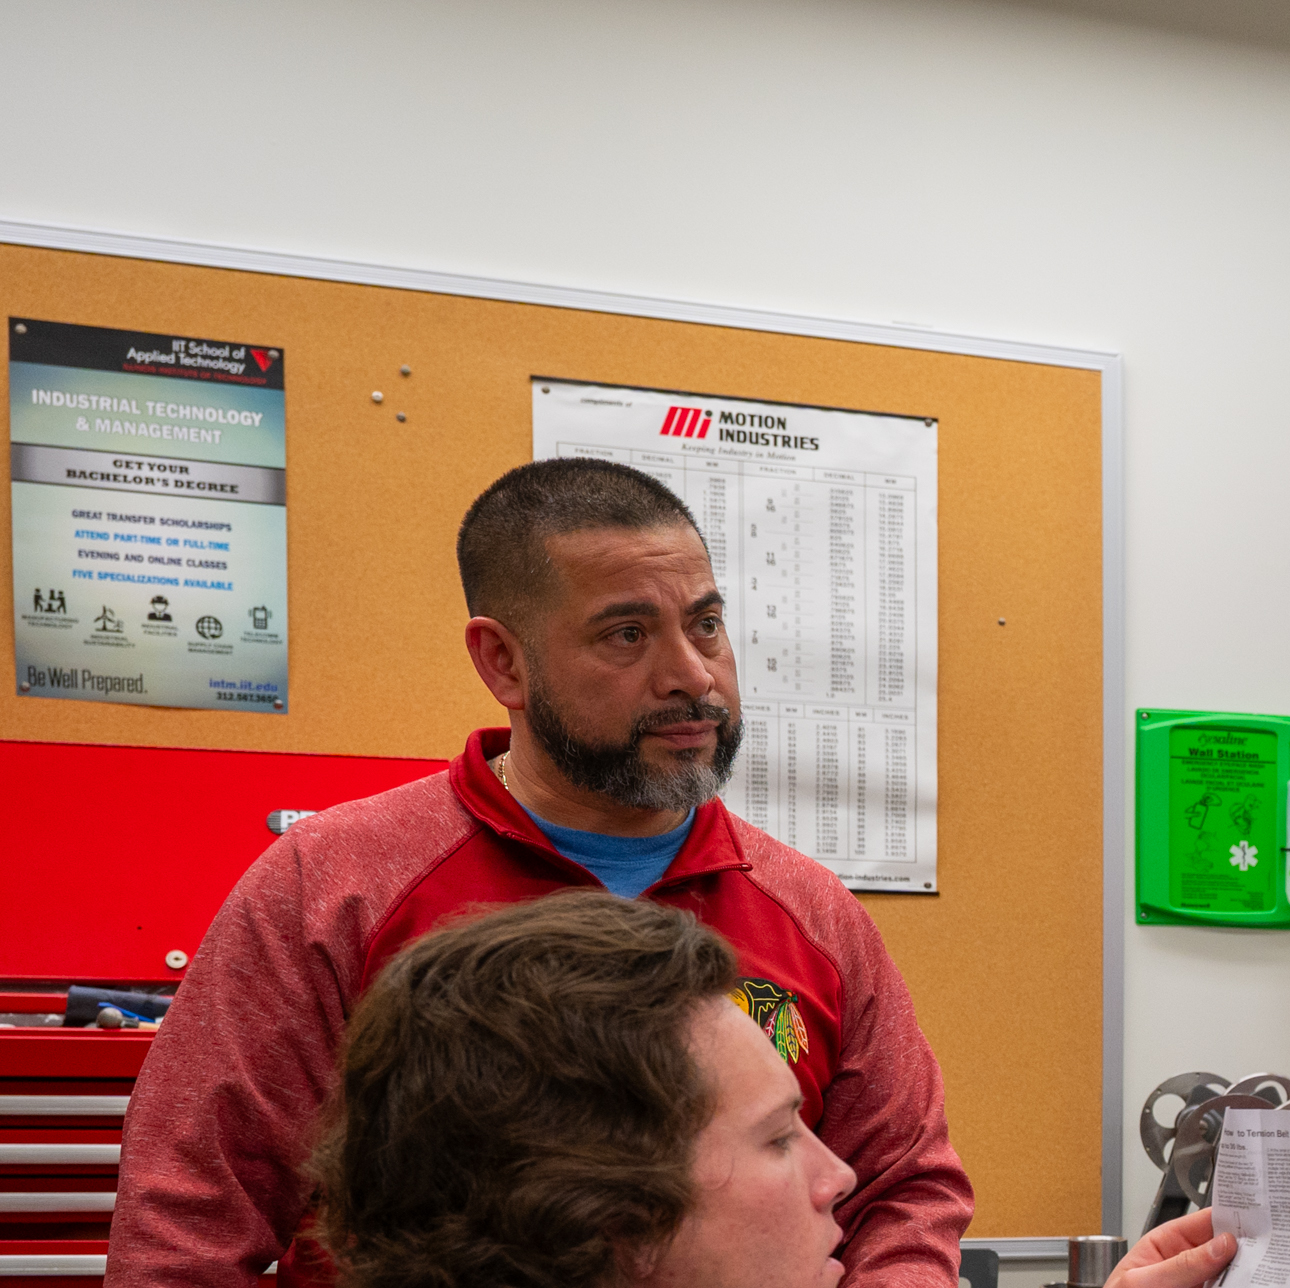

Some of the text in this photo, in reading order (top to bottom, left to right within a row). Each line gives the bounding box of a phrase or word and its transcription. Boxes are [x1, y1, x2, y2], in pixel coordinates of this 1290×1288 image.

[126, 347, 246, 374] Applied Technology
[188, 341, 230, 357] School
[232, 347, 246, 360] of
[31, 388, 263, 427] INDUSTRIAL TECHNOLOGY
[76, 416, 222, 444] & MANAGEMENT
[719, 411, 787, 431] MOTION
[719, 428, 820, 451] INDUSTRIES
[681, 443, 796, 462] Keeping Industry in Motion
[113, 459, 190, 475] GET YOUR
[66, 468, 239, 494] BACHELOR'S DEGREE
[71, 509, 232, 532] GREAT TRANSFER SCHOLARSHIPS
[74, 529, 230, 552] ATTEND PART-TIME OR FULL-TIME
[77, 549, 228, 571] EVENING AND ONLINE CLASSES
[72, 568, 234, 592] FIVE SPECIALIZATIONS AVAILABLE
[27, 665, 148, 697] Be Well Prepared.
[208, 678, 279, 693] intm.iit.edu
[1188, 747, 1259, 759] Wall Station
[1246, 1129, 1275, 1138] Tension
[1276, 1130, 1290, 1138] Belt
